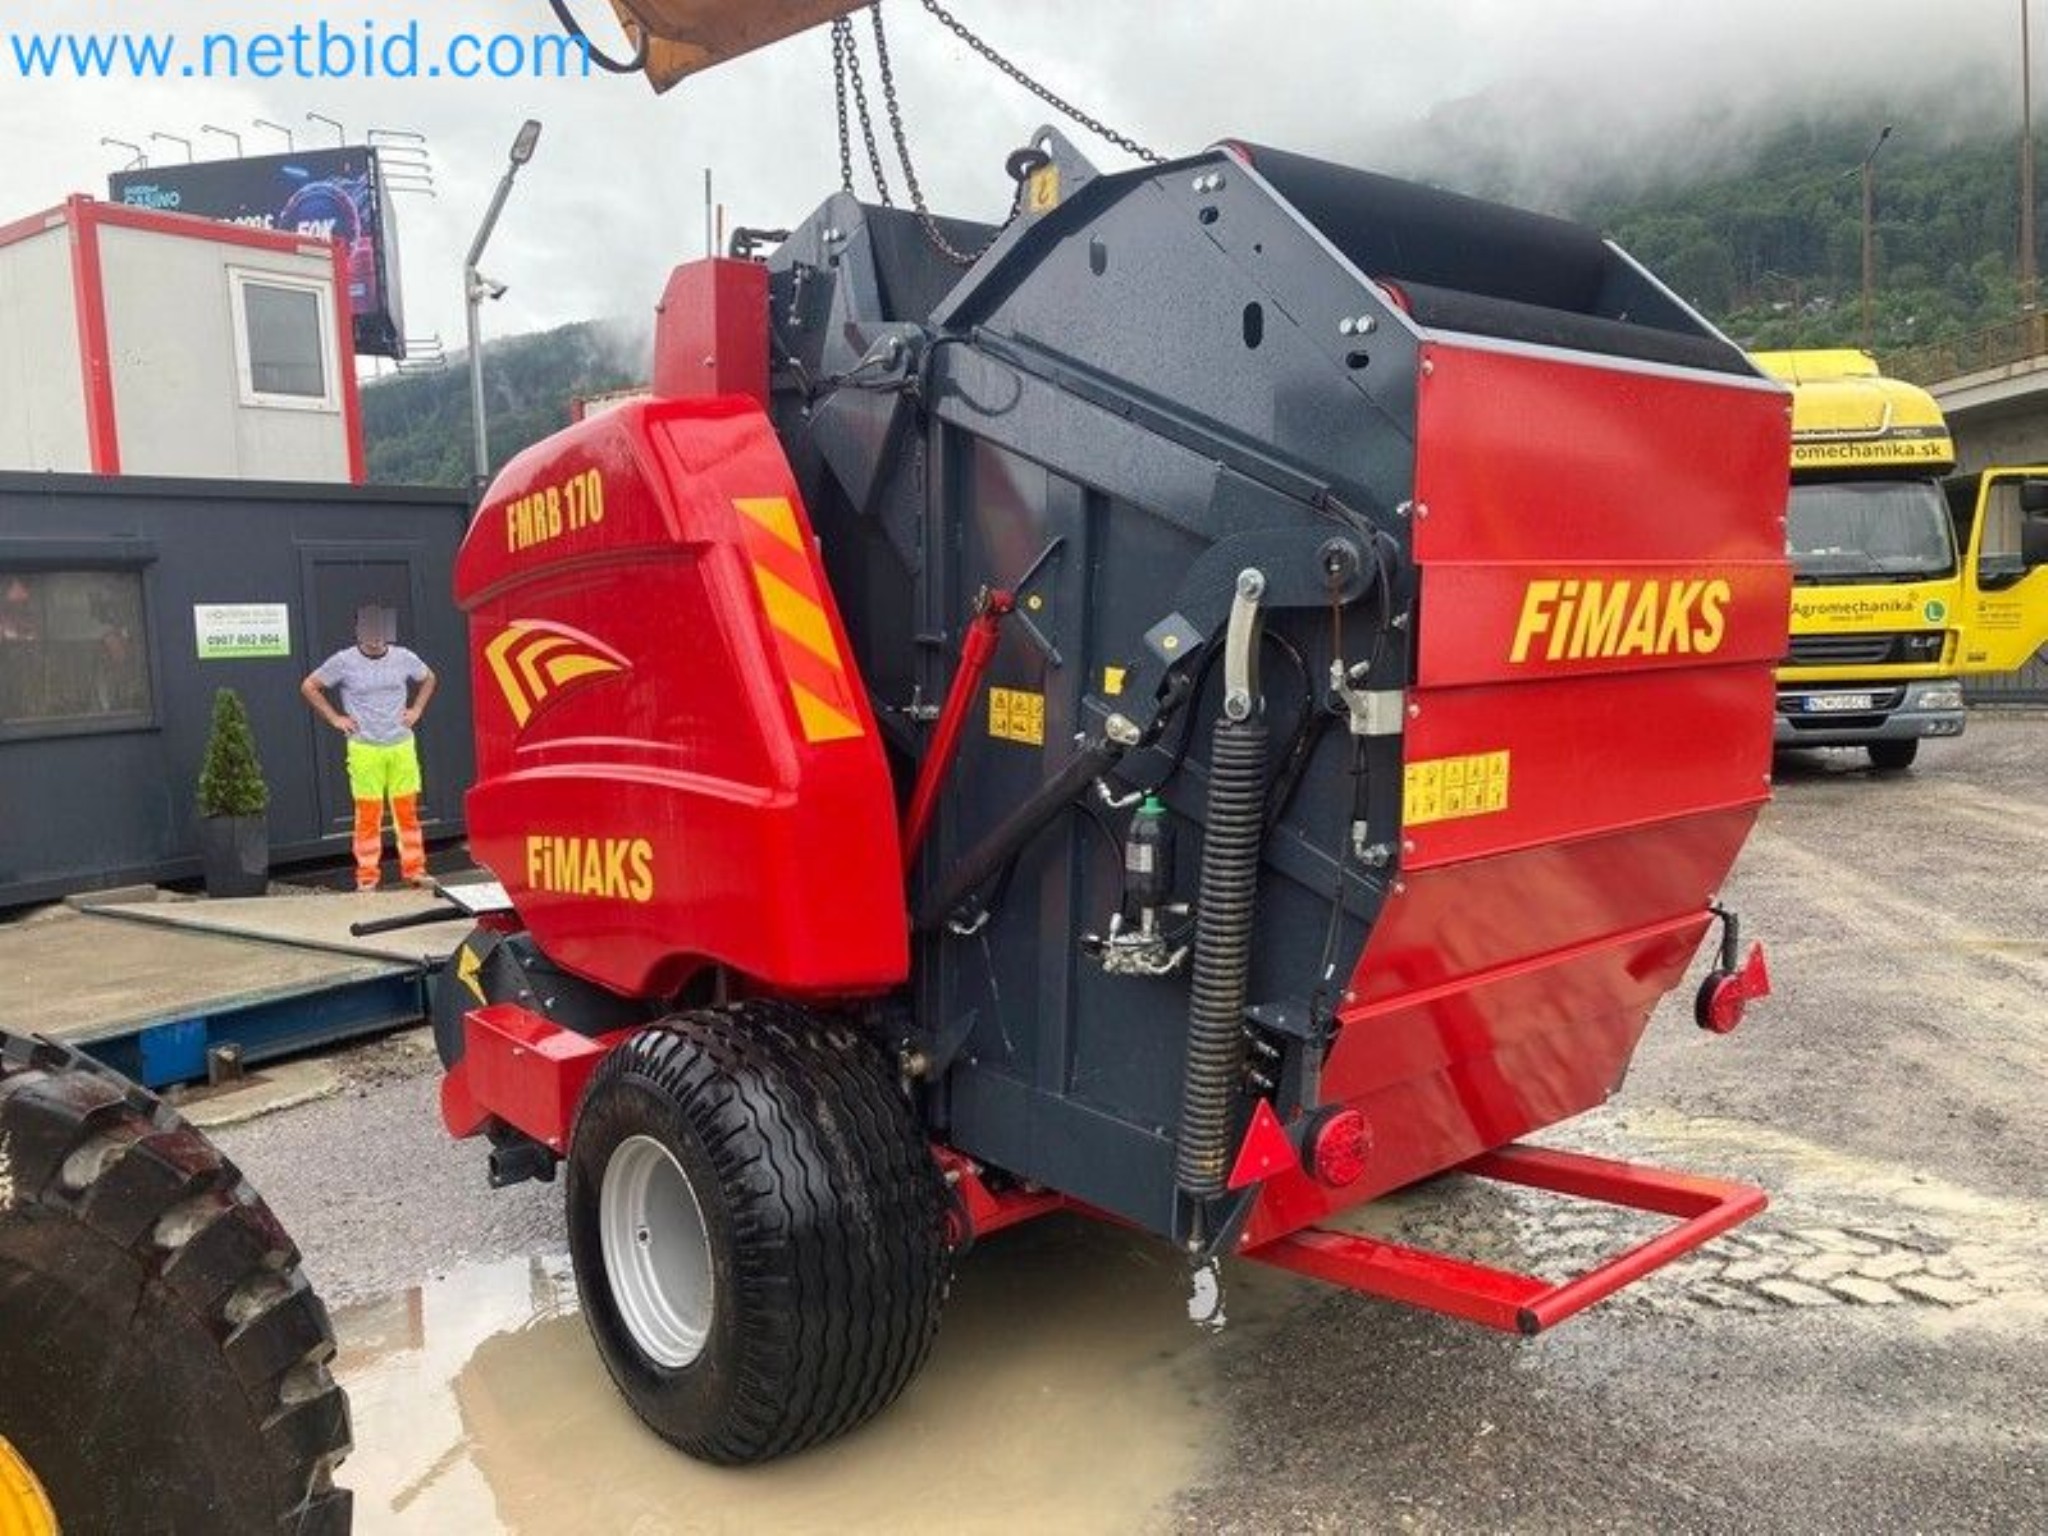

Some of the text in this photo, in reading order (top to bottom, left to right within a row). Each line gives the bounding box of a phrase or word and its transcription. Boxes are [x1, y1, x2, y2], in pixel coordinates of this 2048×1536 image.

[506, 467, 604, 553] FMRB 170
[1508, 579, 1731, 663] FiMAKS
[526, 835, 653, 903] FiMAKS
